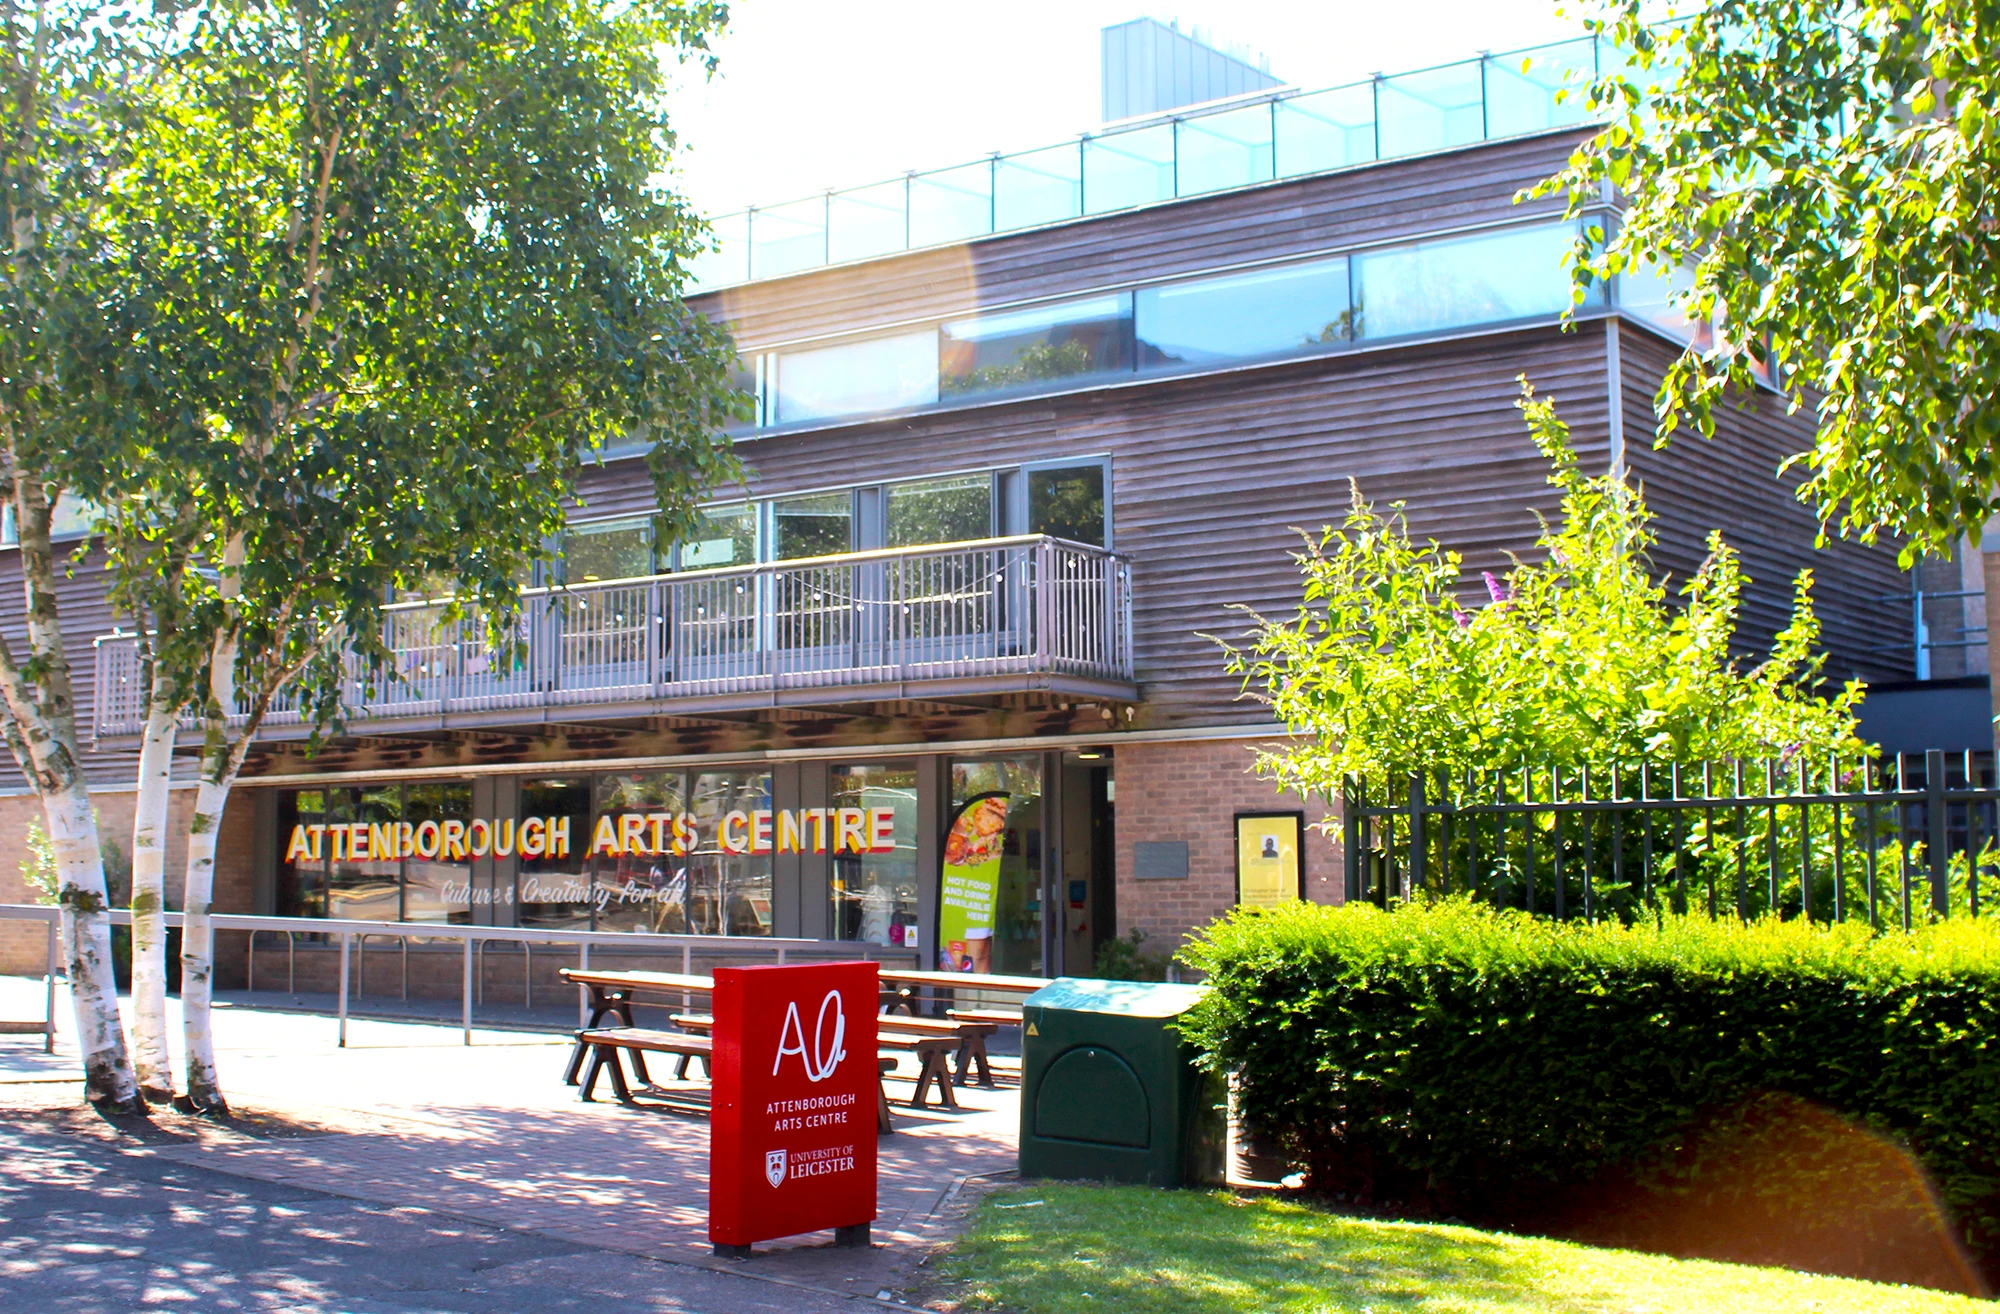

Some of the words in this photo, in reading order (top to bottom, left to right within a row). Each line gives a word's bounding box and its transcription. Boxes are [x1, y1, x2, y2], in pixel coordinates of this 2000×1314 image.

[286, 815, 570, 864] ATTENBOROUGH
[586, 812, 699, 860] ARTS
[718, 806, 896, 855] CENTRE
[947, 876, 966, 886] HOT
[967, 880, 991, 891] FOOD
[441, 879, 500, 904] Culture
[504, 885, 514, 905] &
[522, 878, 611, 911] Creativity
[944, 886, 963, 896] AND
[964, 890, 990, 901] DRINK
[944, 896, 991, 912] AVAILABLE
[966, 911, 989, 922] HERE
[766, 1093, 856, 1115] ATTENBOROUGH
[774, 1117, 802, 1132] ARTS
[805, 1111, 848, 1128] CENTRE
[790, 1147, 841, 1163] UNIVERSITY
[842, 1145, 854, 1156] OF
[790, 1156, 854, 1179] LEICESTER
